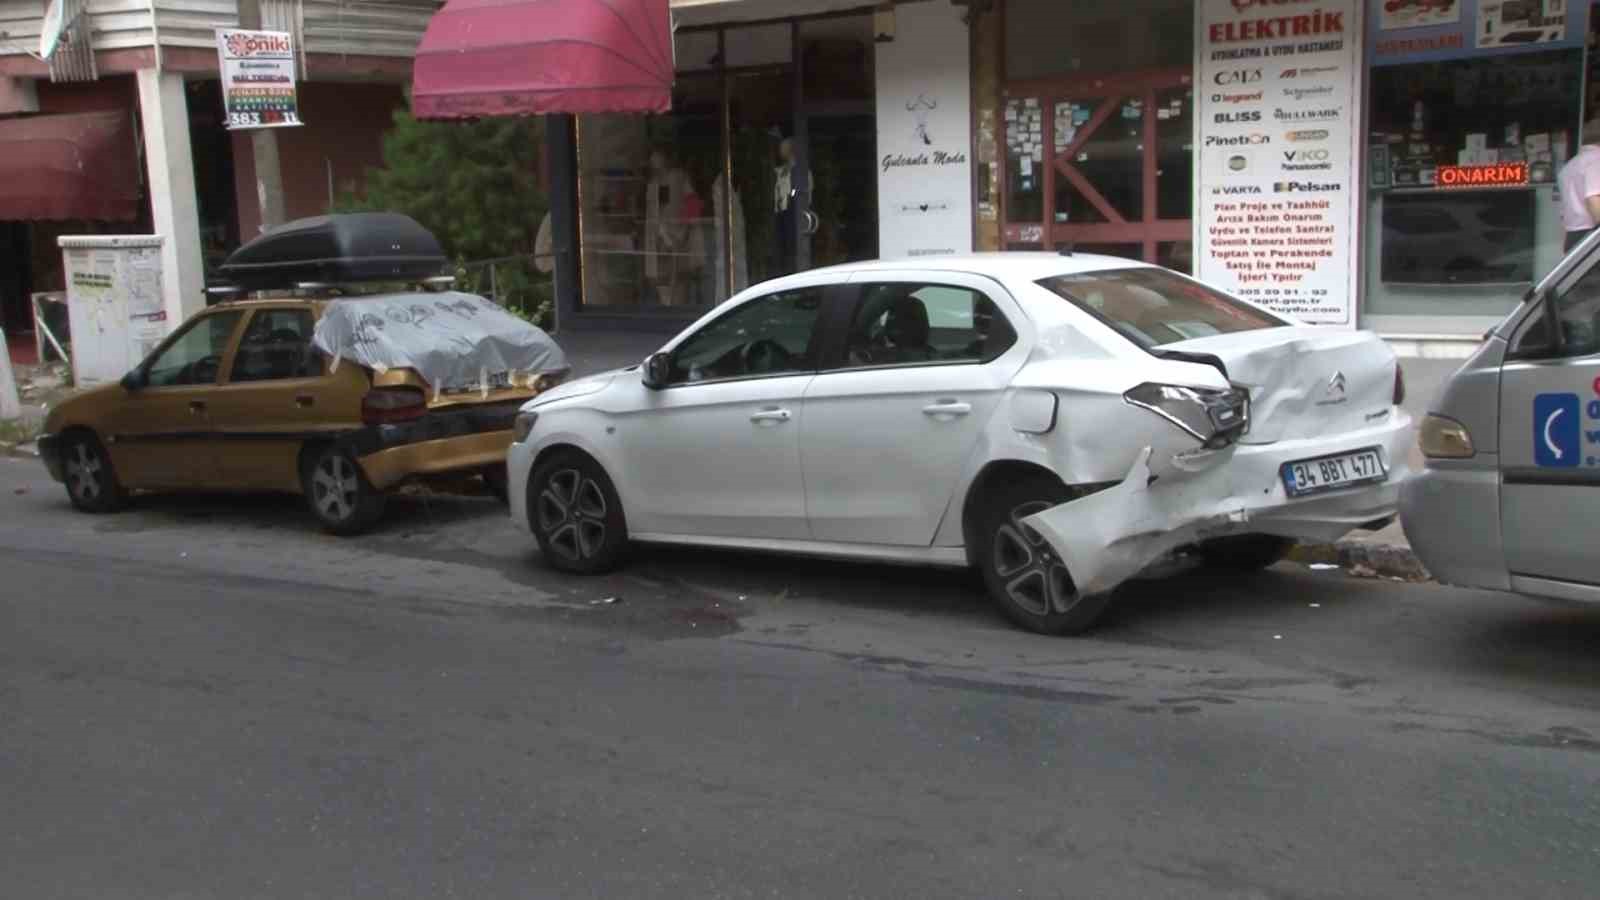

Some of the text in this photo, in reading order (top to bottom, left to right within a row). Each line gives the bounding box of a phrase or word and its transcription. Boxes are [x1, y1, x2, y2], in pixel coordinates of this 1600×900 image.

[1208, 9, 1344, 43] ELEKTRİK
[230, 112, 259, 125] 383
[1214, 110, 1262, 123] BLISS
[1205, 133, 1270, 146] Pinetron
[933, 150, 966, 166] Moda
[1281, 162, 1331, 171] Panasonic
[1441, 167, 1522, 184] ONARIM
[1223, 185, 1262, 194] VARTA
[1288, 181, 1341, 193] Pelsan
[1214, 203, 1236, 211] Plan
[1240, 202, 1267, 212] Proje
[1247, 214, 1279, 222] Bakım
[1283, 213, 1323, 222] Onarım
[1209, 226, 1236, 236] Uydu
[1253, 226, 1292, 234] Telefon
[1296, 225, 1335, 233] Santral
[1251, 238, 1284, 246] Kamera
[1287, 237, 1332, 246] Sistemleri
[1210, 250, 1249, 259] Toptan
[1270, 249, 1333, 257] Perakende
[1226, 261, 1252, 271] Satış
[1275, 261, 1316, 271] Montaj
[1295, 453, 1376, 487] 34 BBT 477
